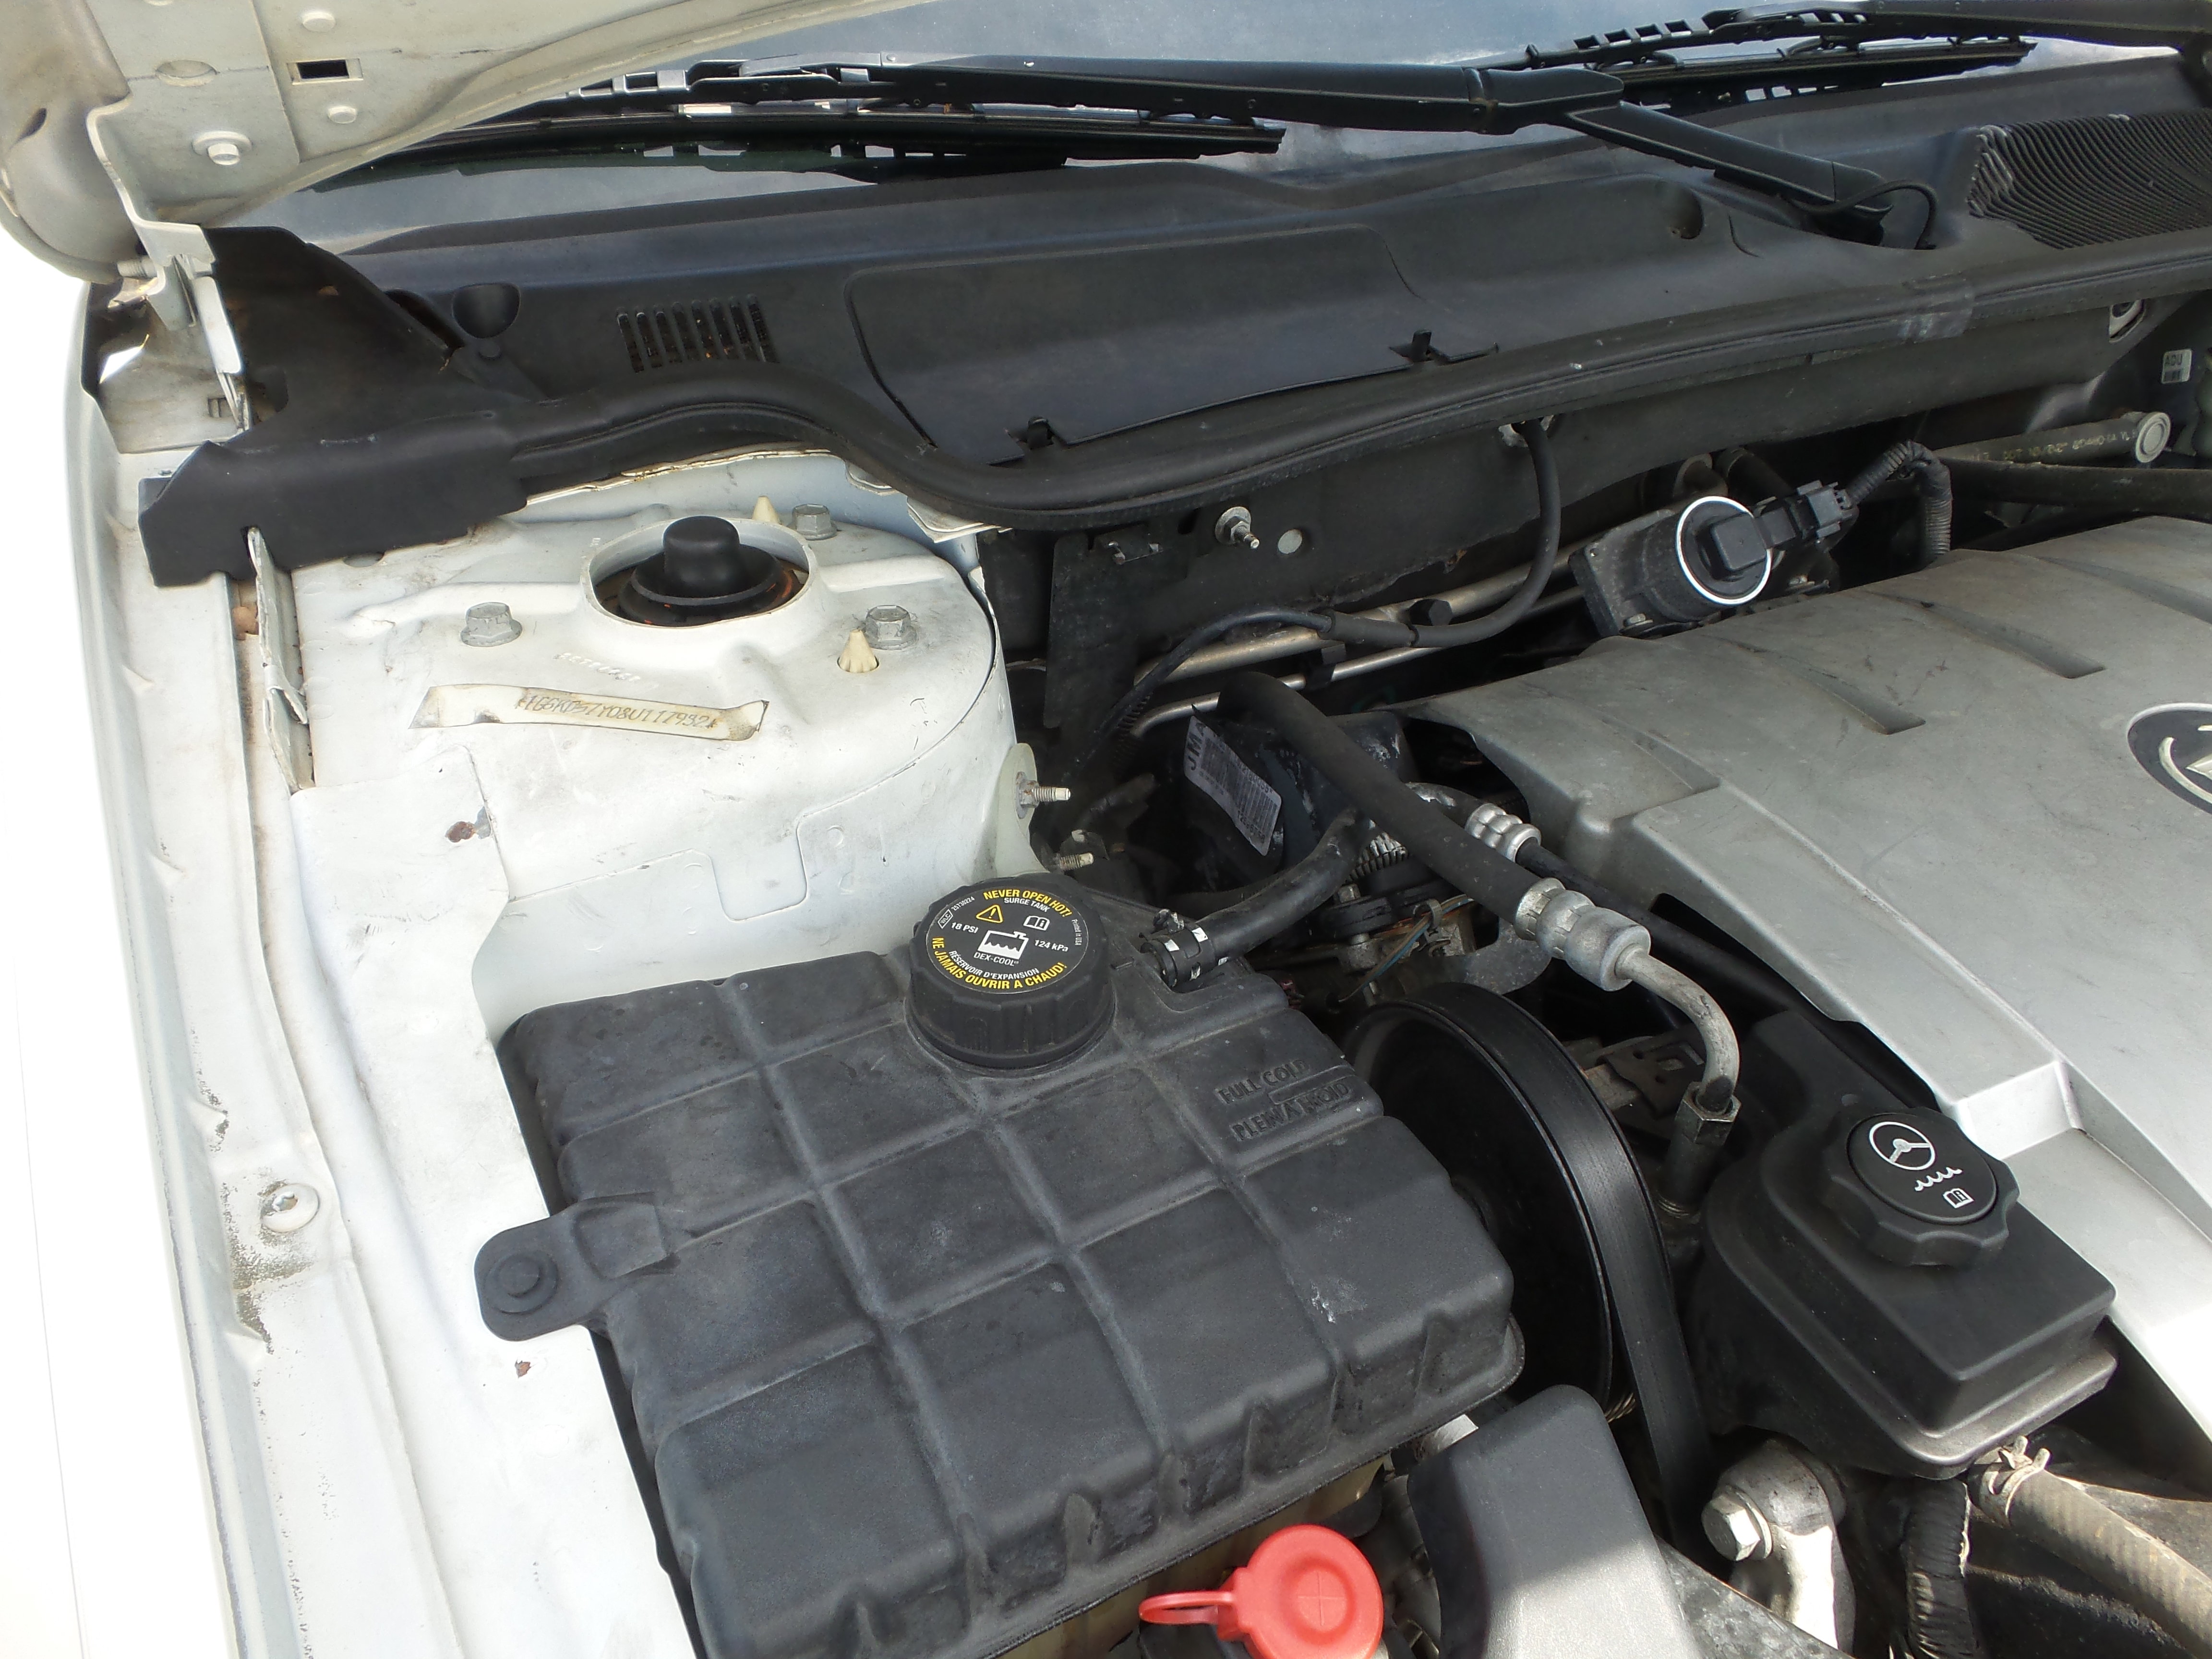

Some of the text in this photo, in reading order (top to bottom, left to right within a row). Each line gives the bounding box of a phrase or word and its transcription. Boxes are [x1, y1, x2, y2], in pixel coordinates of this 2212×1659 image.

[951, 896, 975, 911] 25730224
[983, 889, 1073, 917] NEVER OPEN HOT!
[1004, 897, 1051, 913] SURGE TANK
[940, 914, 951, 924] WLC
[1071, 918, 1082, 933] Printed
[962, 924, 979, 934] PSI
[1034, 939, 1069, 952] 124 kPa
[1074, 937, 1082, 946] USA
[932, 937, 1068, 989] NE JAMAIS OUVRIR A CHAUD!
[948, 950, 1040, 980] RÉSERVOIR D'EXPANSION
[973, 951, 1015, 967] DEX-COOL
[1217, 1059, 1310, 1105] FULL COLD
[1232, 1105, 1286, 1142] PLEIN
[1283, 1101, 1301, 1119] A
